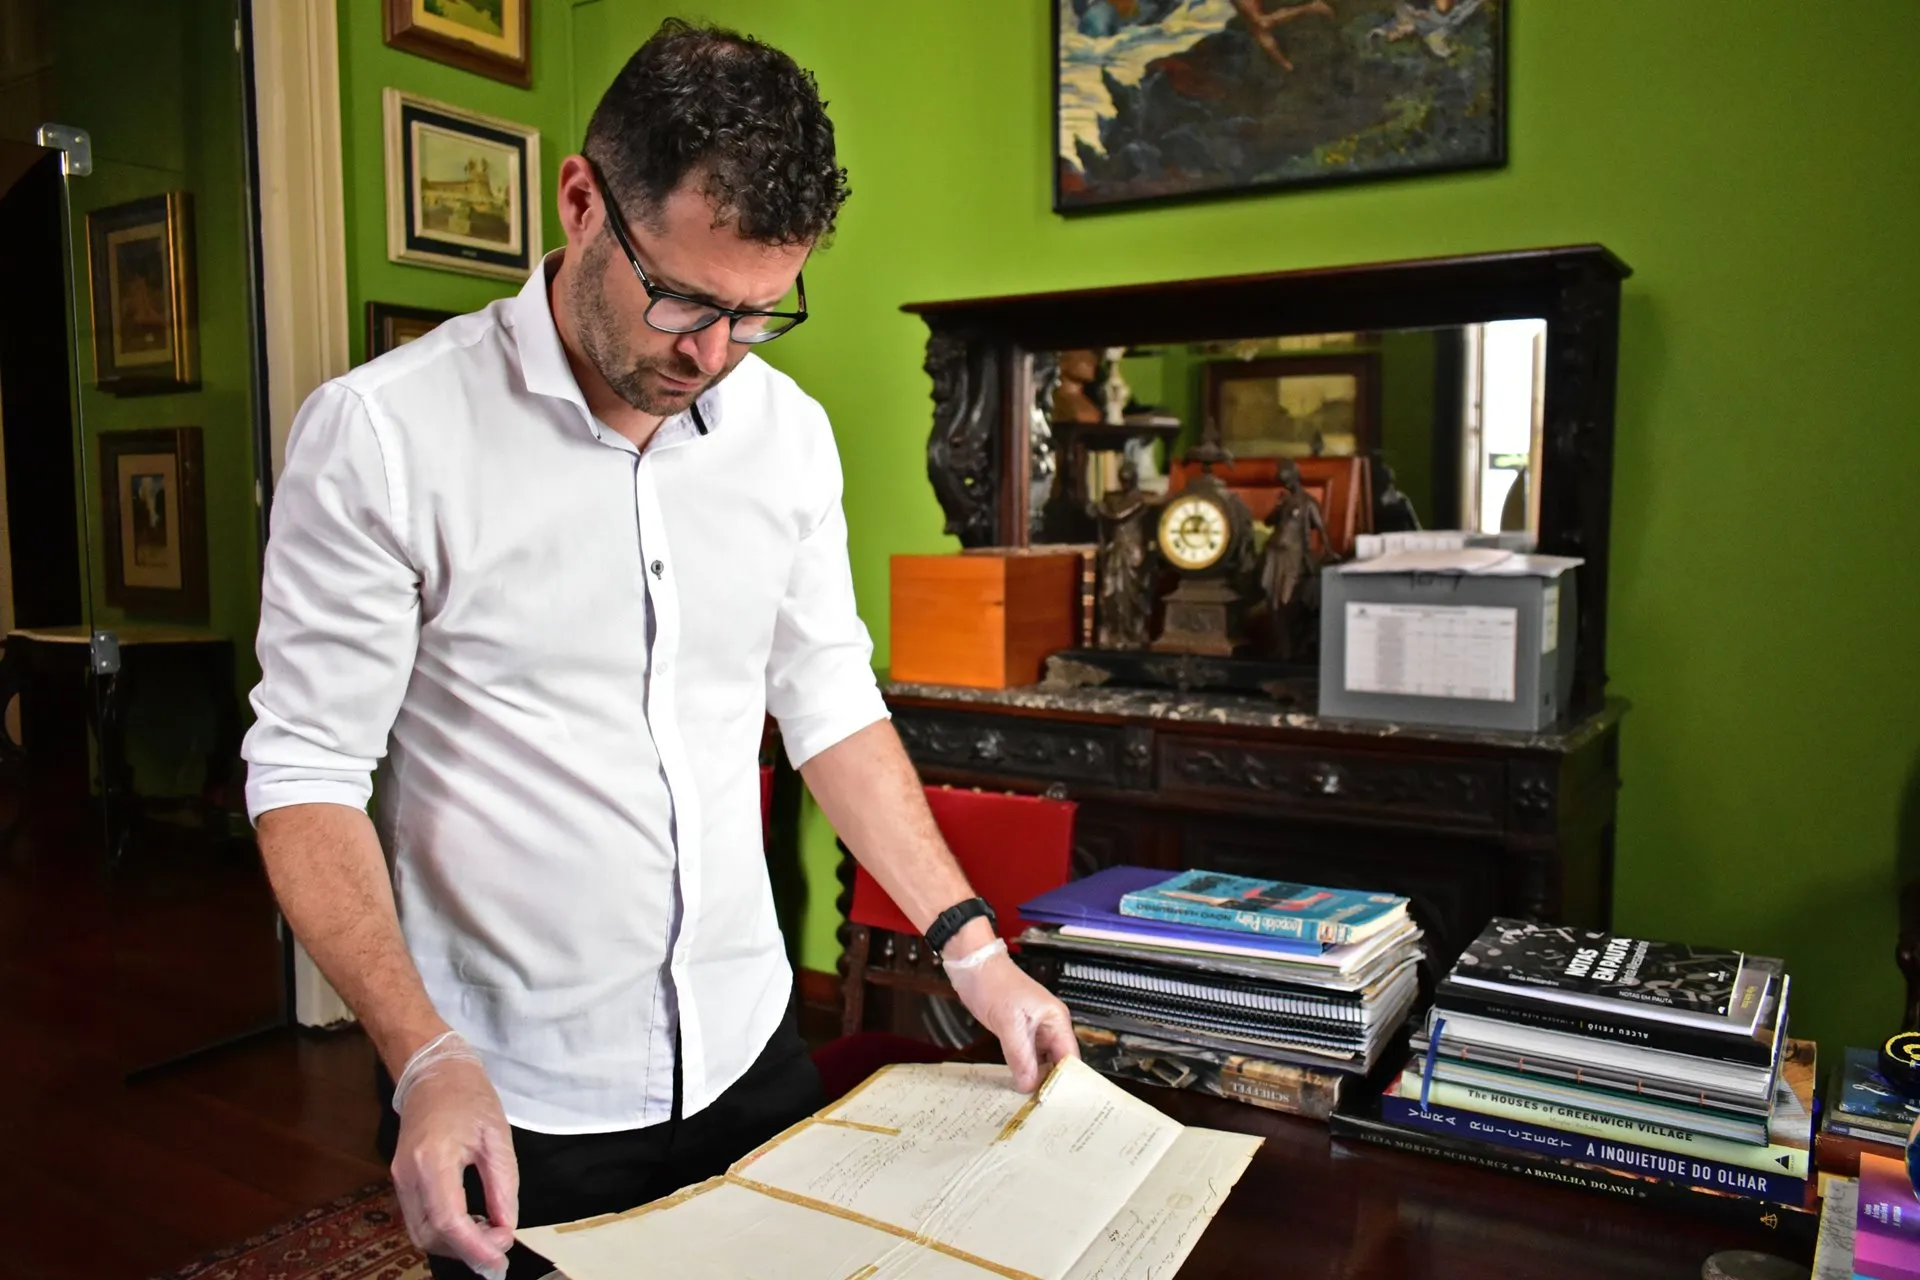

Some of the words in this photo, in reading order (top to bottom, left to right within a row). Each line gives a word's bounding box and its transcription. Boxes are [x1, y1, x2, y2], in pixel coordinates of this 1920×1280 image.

[1200, 912, 1232, 921] NOVO
[1235, 910, 1261, 932] Petry
[1261, 914, 1302, 938] Leopoldo
[1564, 947, 1599, 977] NOTAS
[1600, 938, 1632, 968] PAUTA
[1592, 966, 1618, 982] EM
[1618, 991, 1640, 1000] NOTAS
[1651, 995, 1673, 1005] PAUTA
[1618, 1029, 1649, 1040] ALCEU
[1231, 1083, 1290, 1103] SCHEFFEL
[1408, 1107, 1456, 1126] VERA
[1469, 1121, 1573, 1148] REICHERT
[1468, 1089, 1487, 1101] The
[1491, 1094, 1539, 1111] HOUSES
[1543, 1105, 1553, 1114] of
[1557, 1108, 1633, 1130] GREENWICH
[1638, 1122, 1694, 1142] VILLAGE
[1394, 1141, 1441, 1156] MORITZ
[1443, 1151, 1509, 1170] SCHWARCZ
[1586, 1142, 1596, 1157] A
[1601, 1144, 1686, 1176] INQUIETUDE
[1691, 1163, 1712, 1180] DO
[1717, 1169, 1768, 1192] OLHAR
[1524, 1167, 1533, 1175] A
[1534, 1170, 1588, 1187] BATALHA
[1590, 1180, 1608, 1191] DO
[1608, 1185, 1636, 1197] AVAÍ
